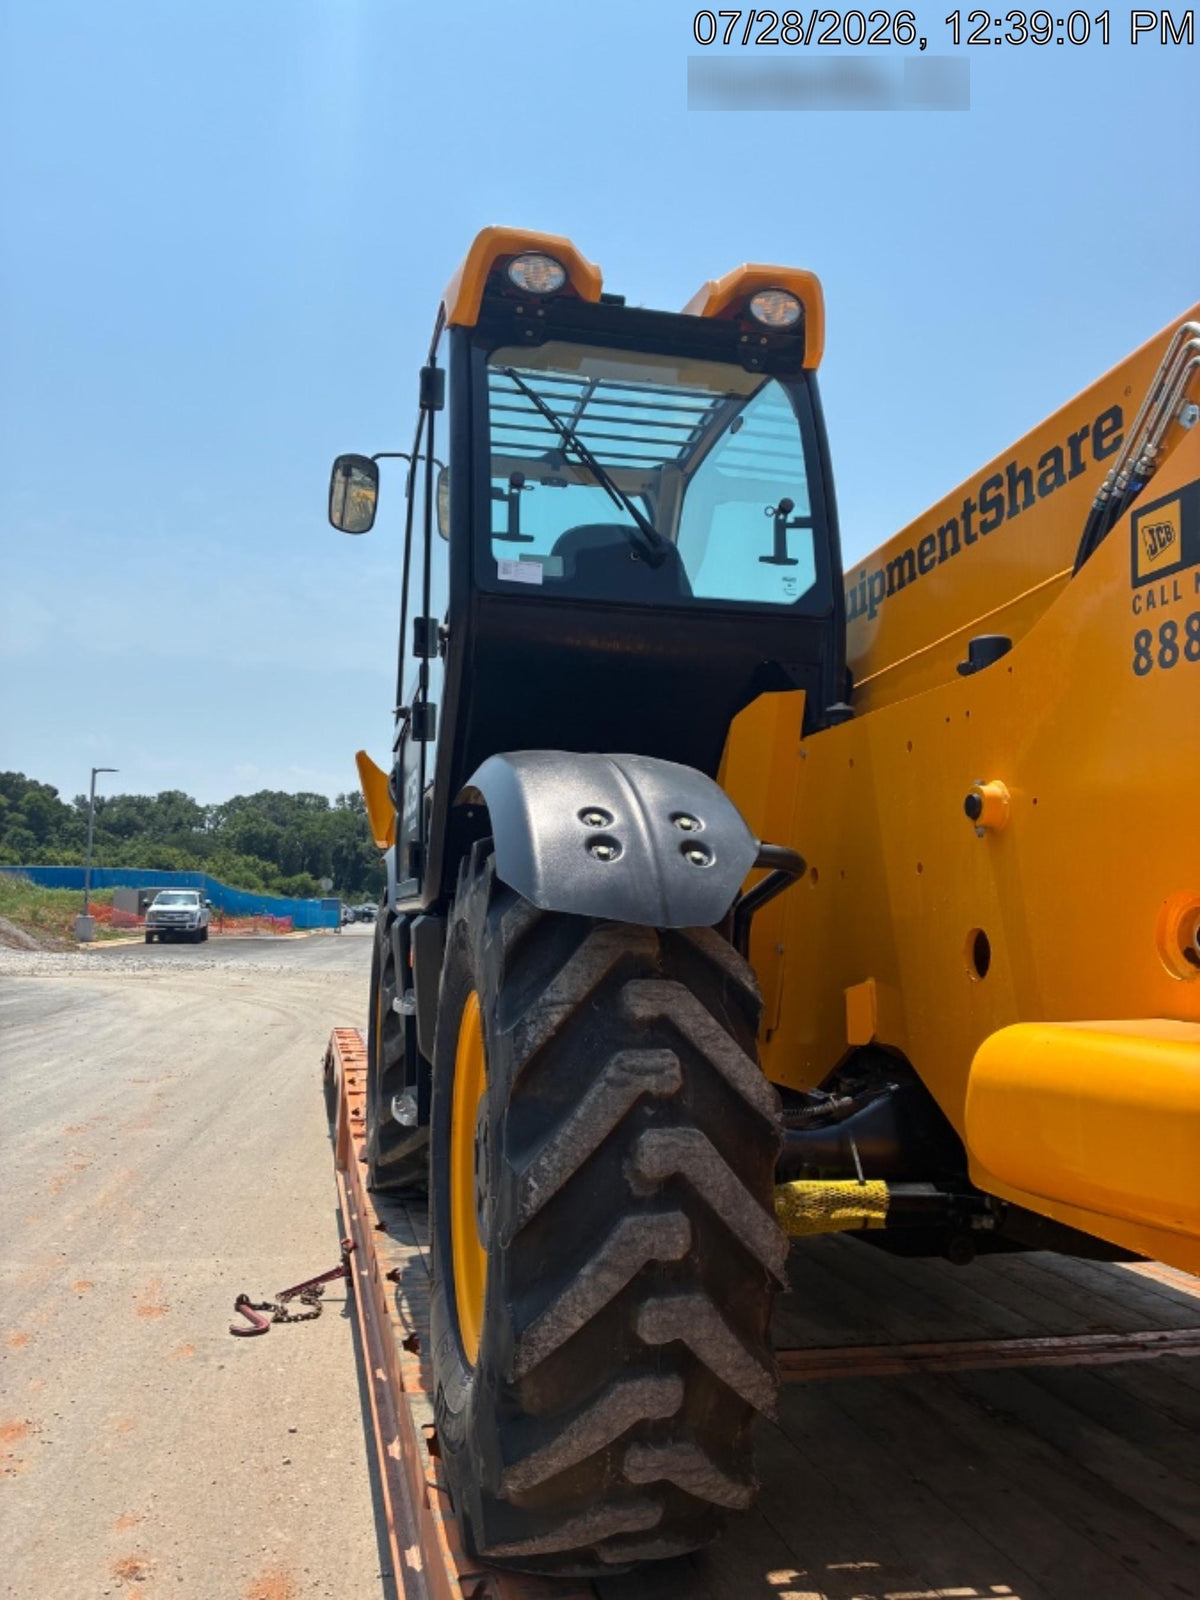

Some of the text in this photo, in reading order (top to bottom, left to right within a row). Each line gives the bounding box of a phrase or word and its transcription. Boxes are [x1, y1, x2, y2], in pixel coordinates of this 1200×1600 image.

[844, 404, 1124, 624] uipmentShare
[1148, 524, 1173, 556] JCB
[1132, 579, 1182, 616] CALL
